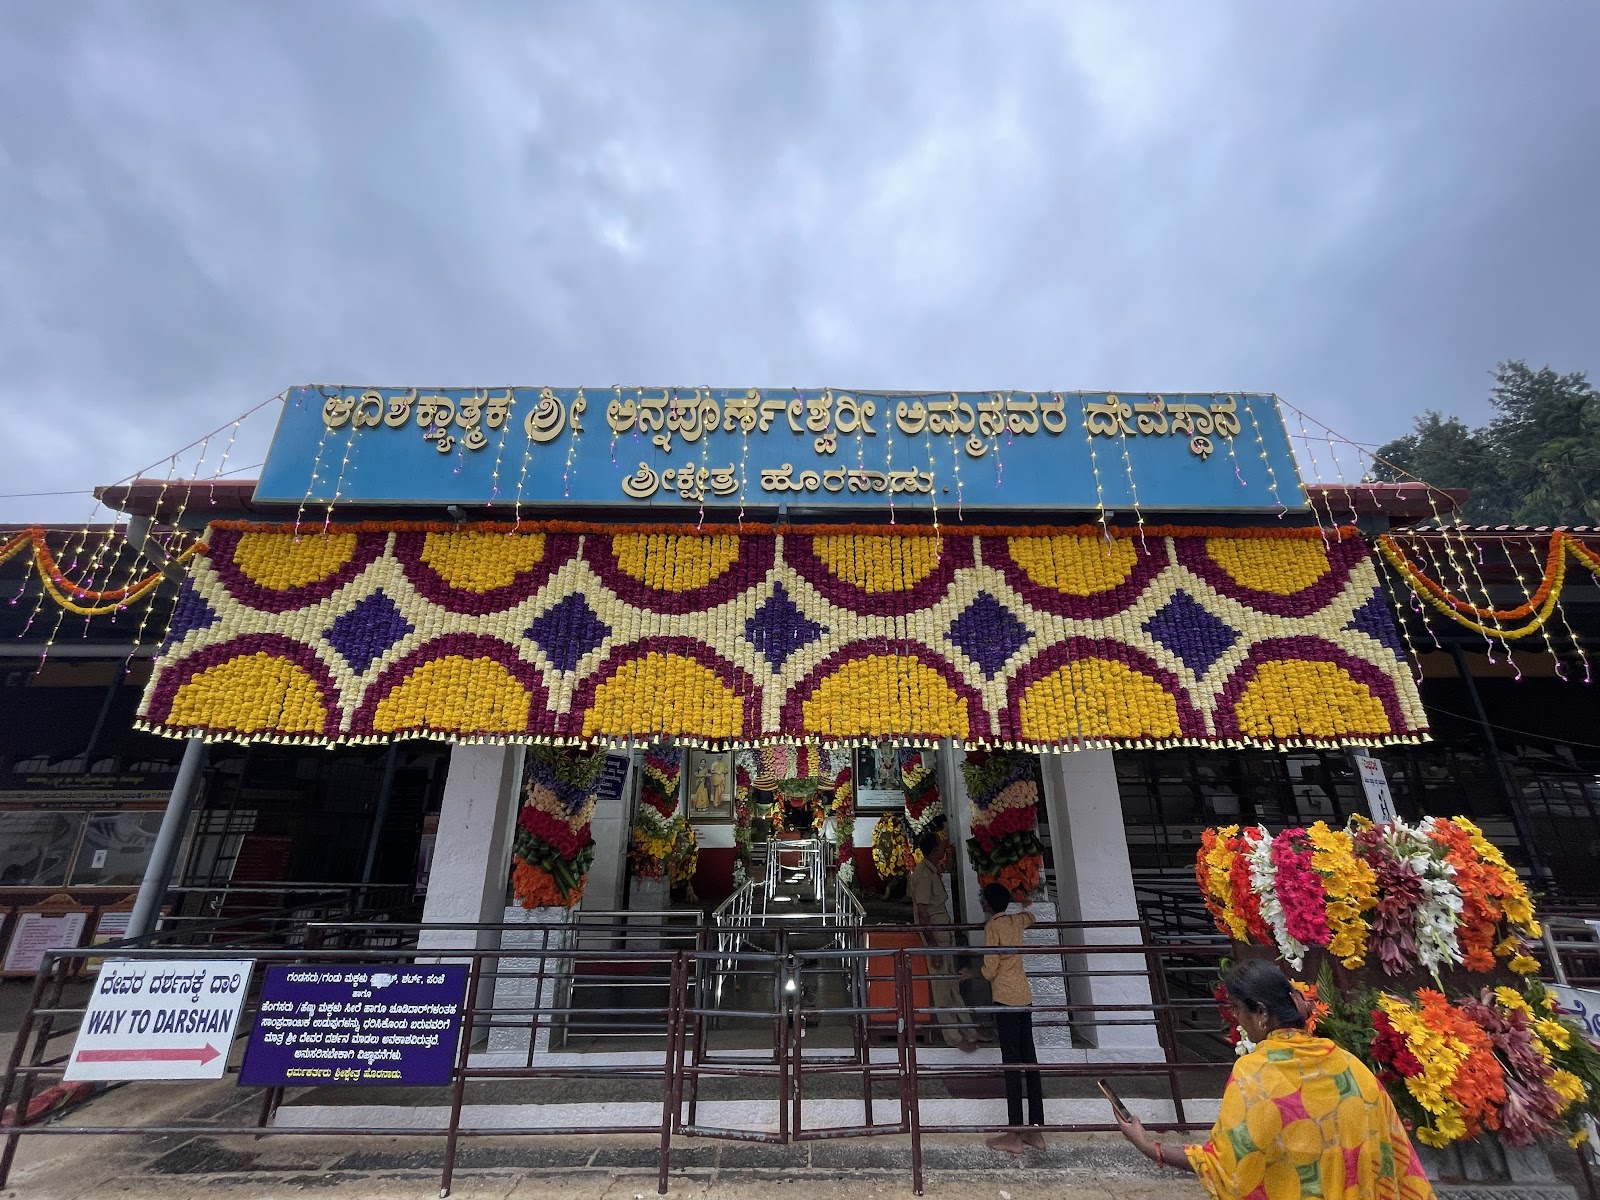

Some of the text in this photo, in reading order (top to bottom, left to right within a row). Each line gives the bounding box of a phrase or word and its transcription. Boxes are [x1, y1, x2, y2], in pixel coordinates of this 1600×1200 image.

[524, 387, 588, 443] ಶ್ರೀ
[606, 388, 877, 454] ಅನ್ನಪೂರ್ಣೇಶ್ವರೀ
[895, 392, 1067, 457] ಅಮ್ಮನವರ
[1087, 394, 1241, 461] ದೇವಸ್ಥಾನ
[622, 461, 739, 502] ಶ್ರೀಕ್ಷೇತ್ರ
[100, 969, 241, 1003] ದೇವರ ದರ್ಶನಕ್ಕೆ ದಾರಿ
[344, 973, 368, 987] ಮಕ್ಕಳು
[87, 1009, 233, 1035] WAY TO DARSHAN
[299, 1032, 323, 1043] ದೇವರ
[325, 1033, 349, 1043] ದರ್ಶನ
